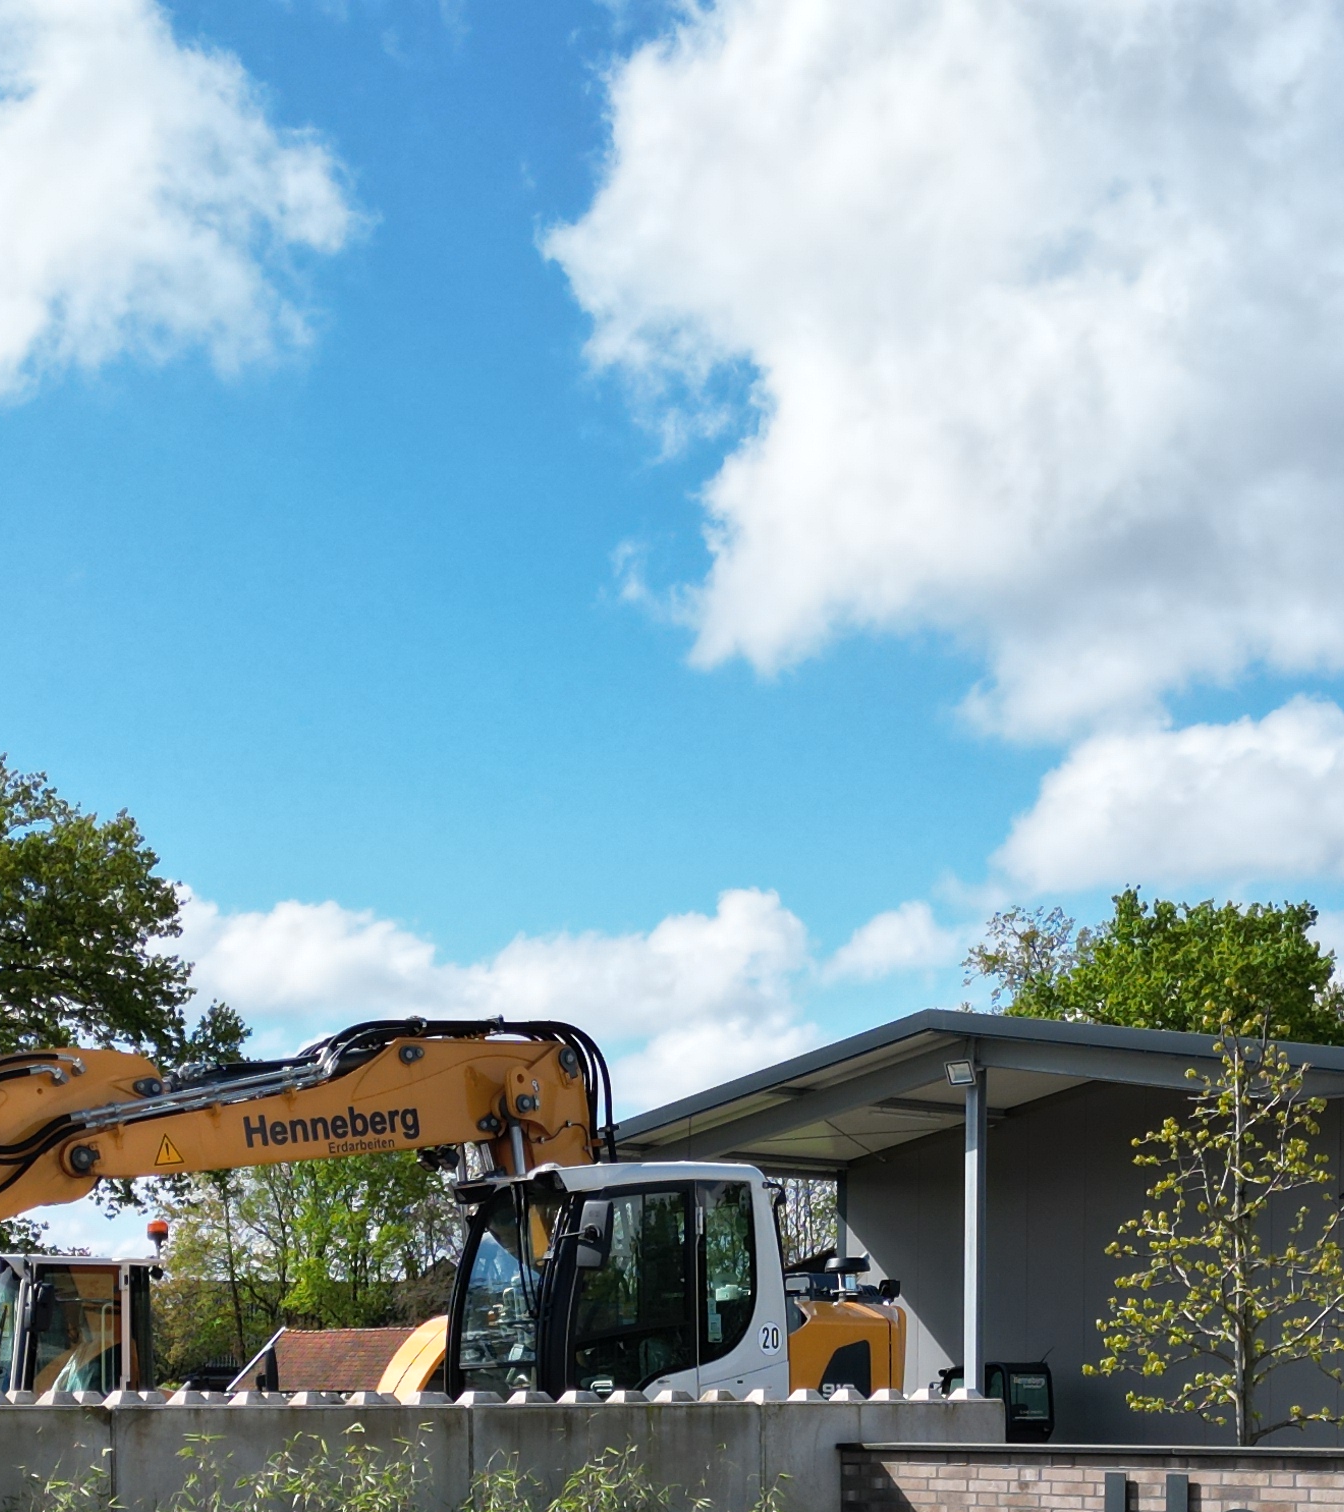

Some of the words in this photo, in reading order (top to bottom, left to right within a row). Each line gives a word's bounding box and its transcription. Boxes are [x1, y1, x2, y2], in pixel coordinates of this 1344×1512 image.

[243, 1106, 420, 1148] Henneberg
[328, 1138, 395, 1154] Erdarbeiten
[762, 1327, 779, 1349] 20
